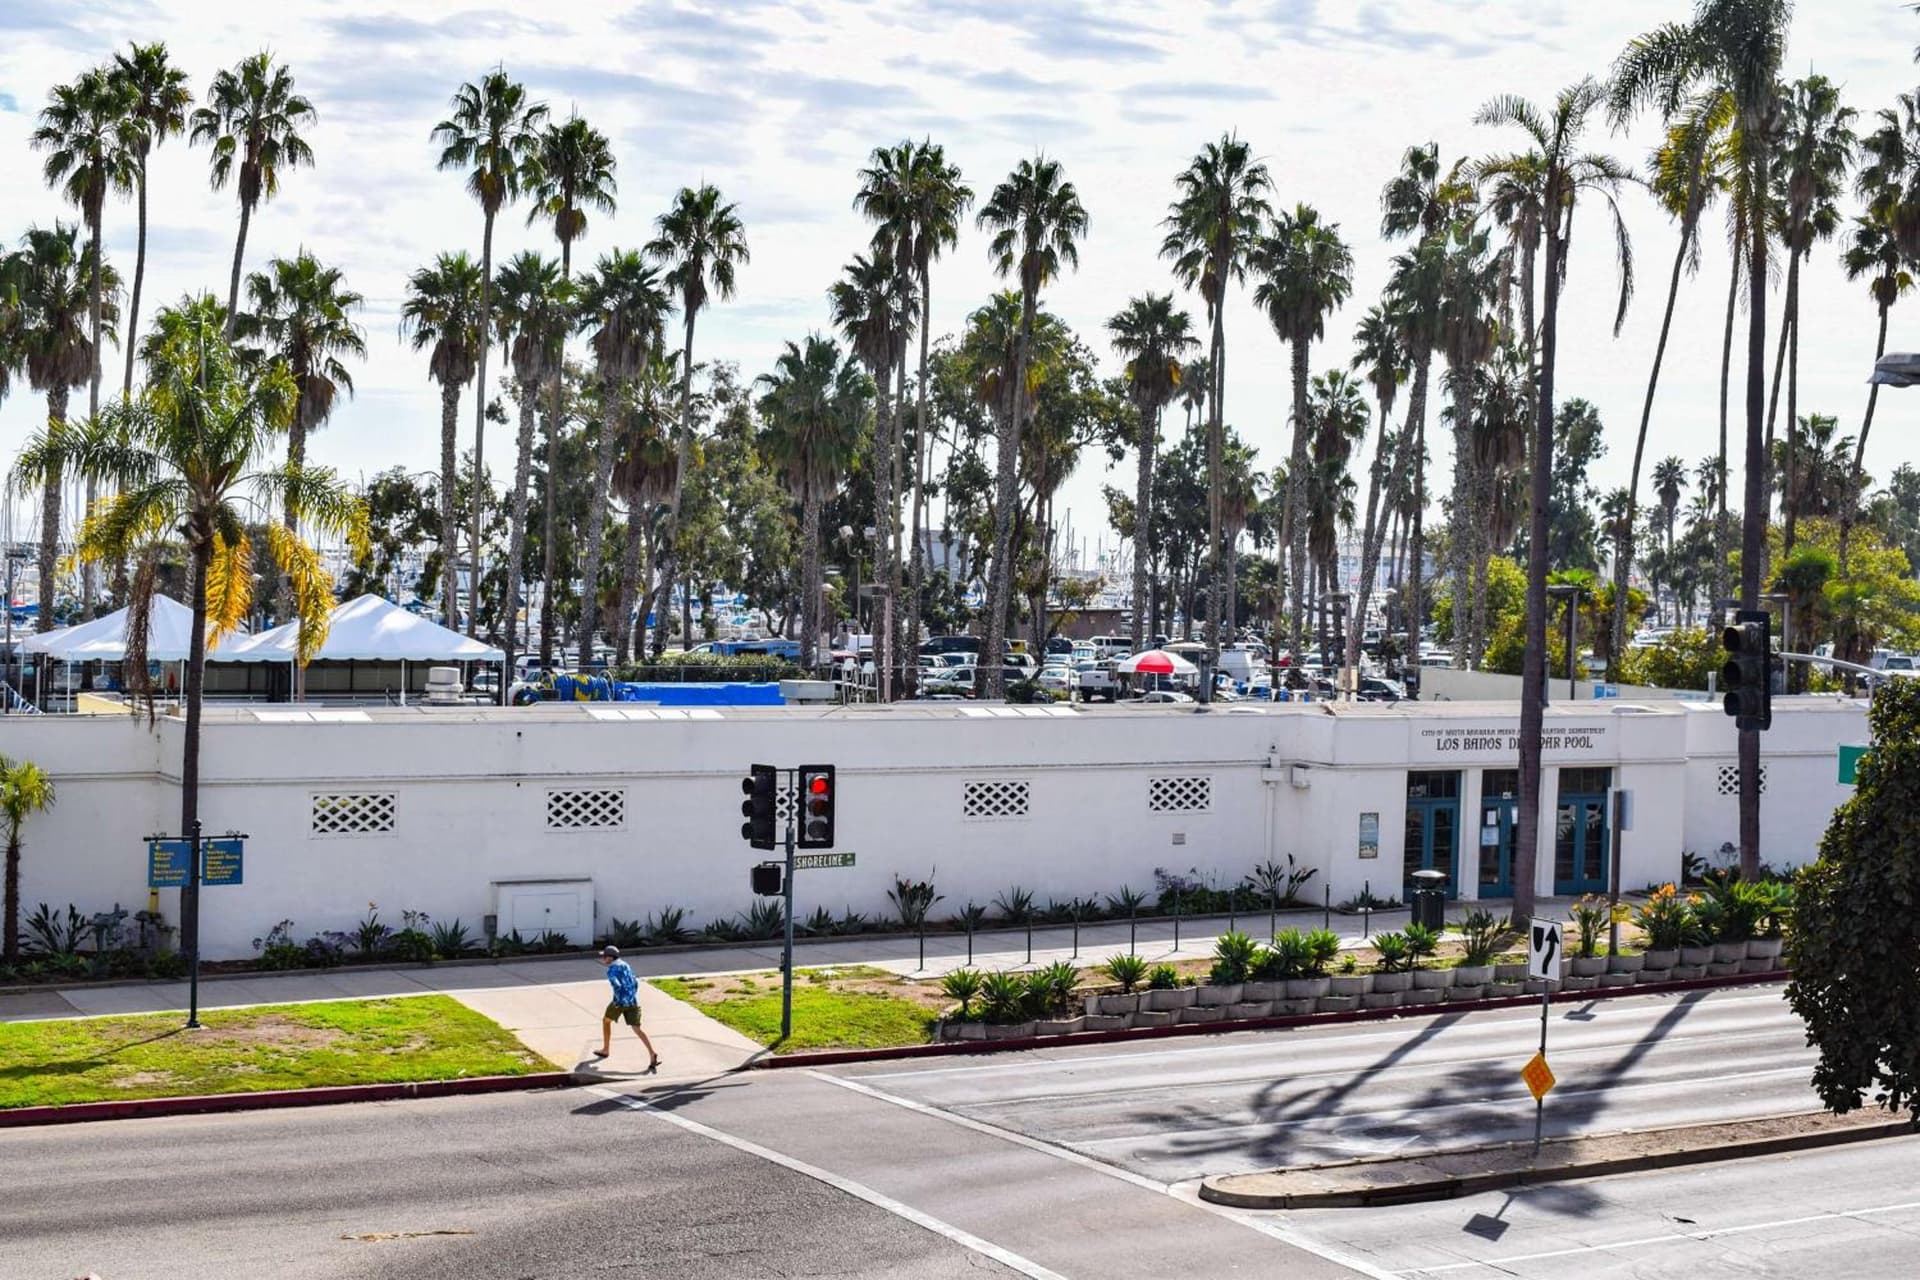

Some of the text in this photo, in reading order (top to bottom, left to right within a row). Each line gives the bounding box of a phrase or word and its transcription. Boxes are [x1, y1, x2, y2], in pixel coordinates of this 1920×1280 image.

[1437, 738, 1459, 751] LOS
[1564, 736, 1593, 749] POOL
[796, 854, 844, 868] SHORELINE
